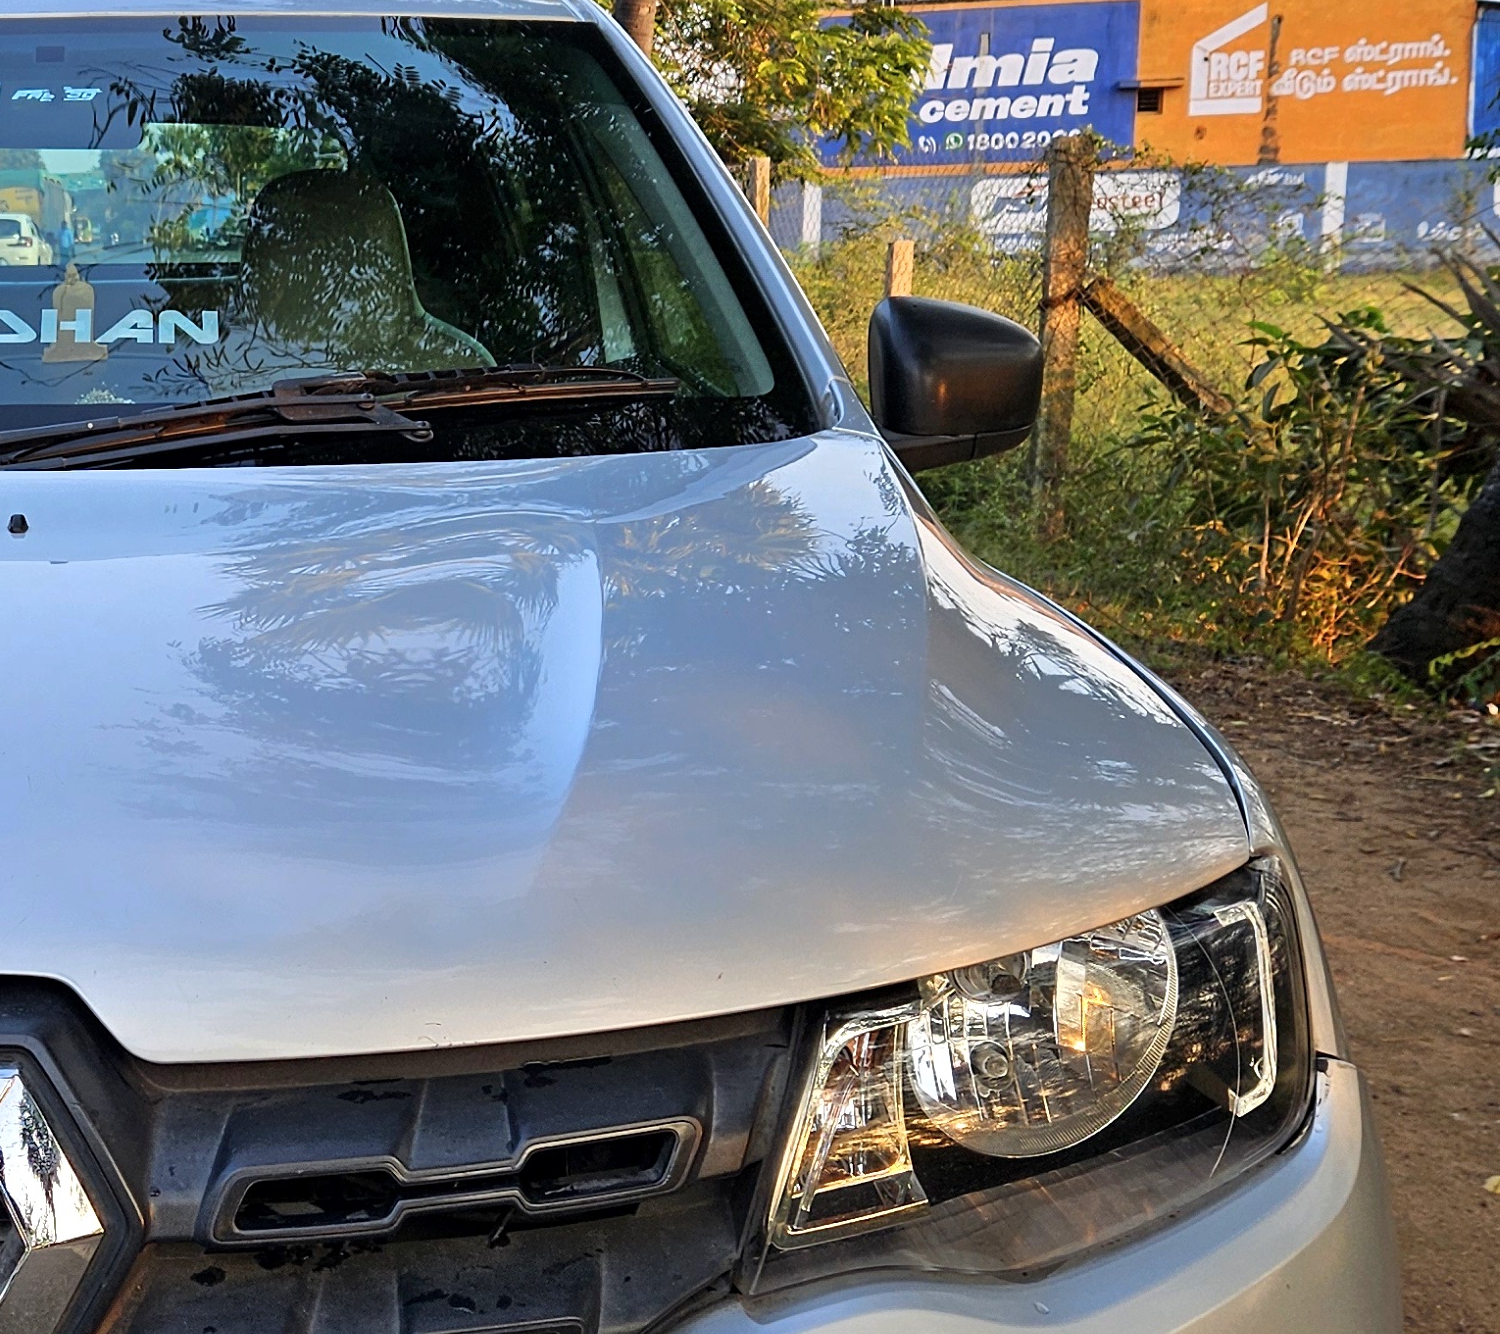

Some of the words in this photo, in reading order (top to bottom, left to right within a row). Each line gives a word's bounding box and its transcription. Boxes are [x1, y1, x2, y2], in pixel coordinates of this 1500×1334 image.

[911, 36, 1099, 90] lmia
[1209, 50, 1266, 81] RCF
[1289, 46, 1340, 67] RCF
[919, 84, 1090, 123] cement
[1208, 79, 1264, 98] EXPERT
